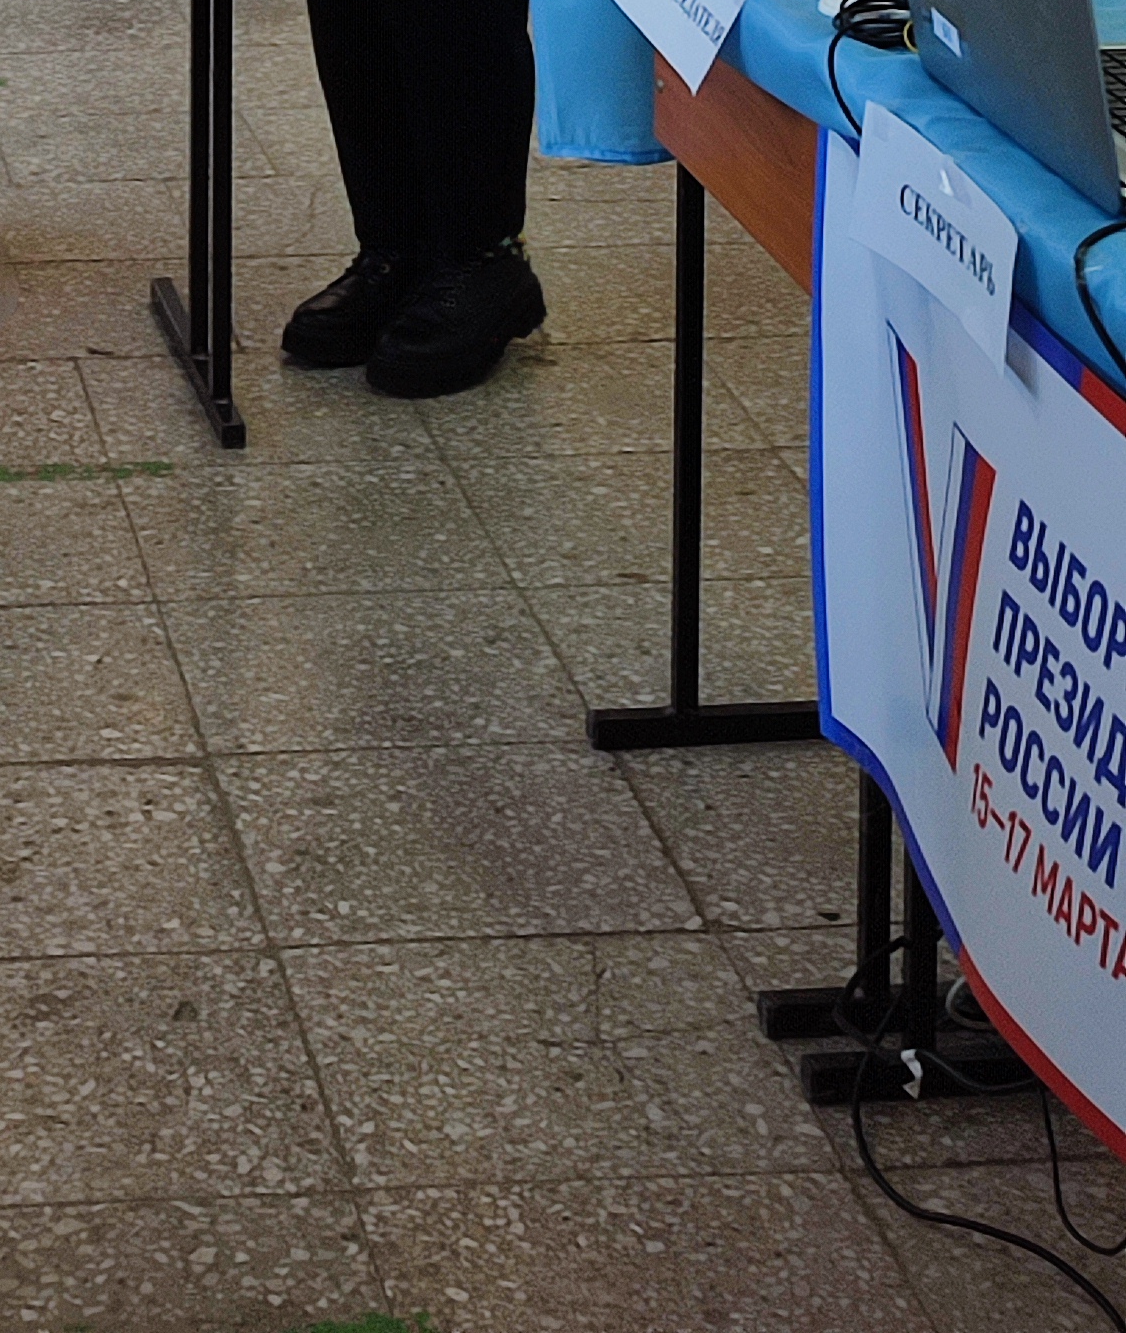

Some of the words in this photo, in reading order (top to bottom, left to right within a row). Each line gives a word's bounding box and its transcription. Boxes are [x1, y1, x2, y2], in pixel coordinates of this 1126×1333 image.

[899, 183, 996, 297] СЕКРЕТАРЬ
[1008, 498, 1126, 671] ВЫБОР
[978, 676, 1122, 890] РОССИИ
[992, 588, 1126, 809] ПРЕЗИД
